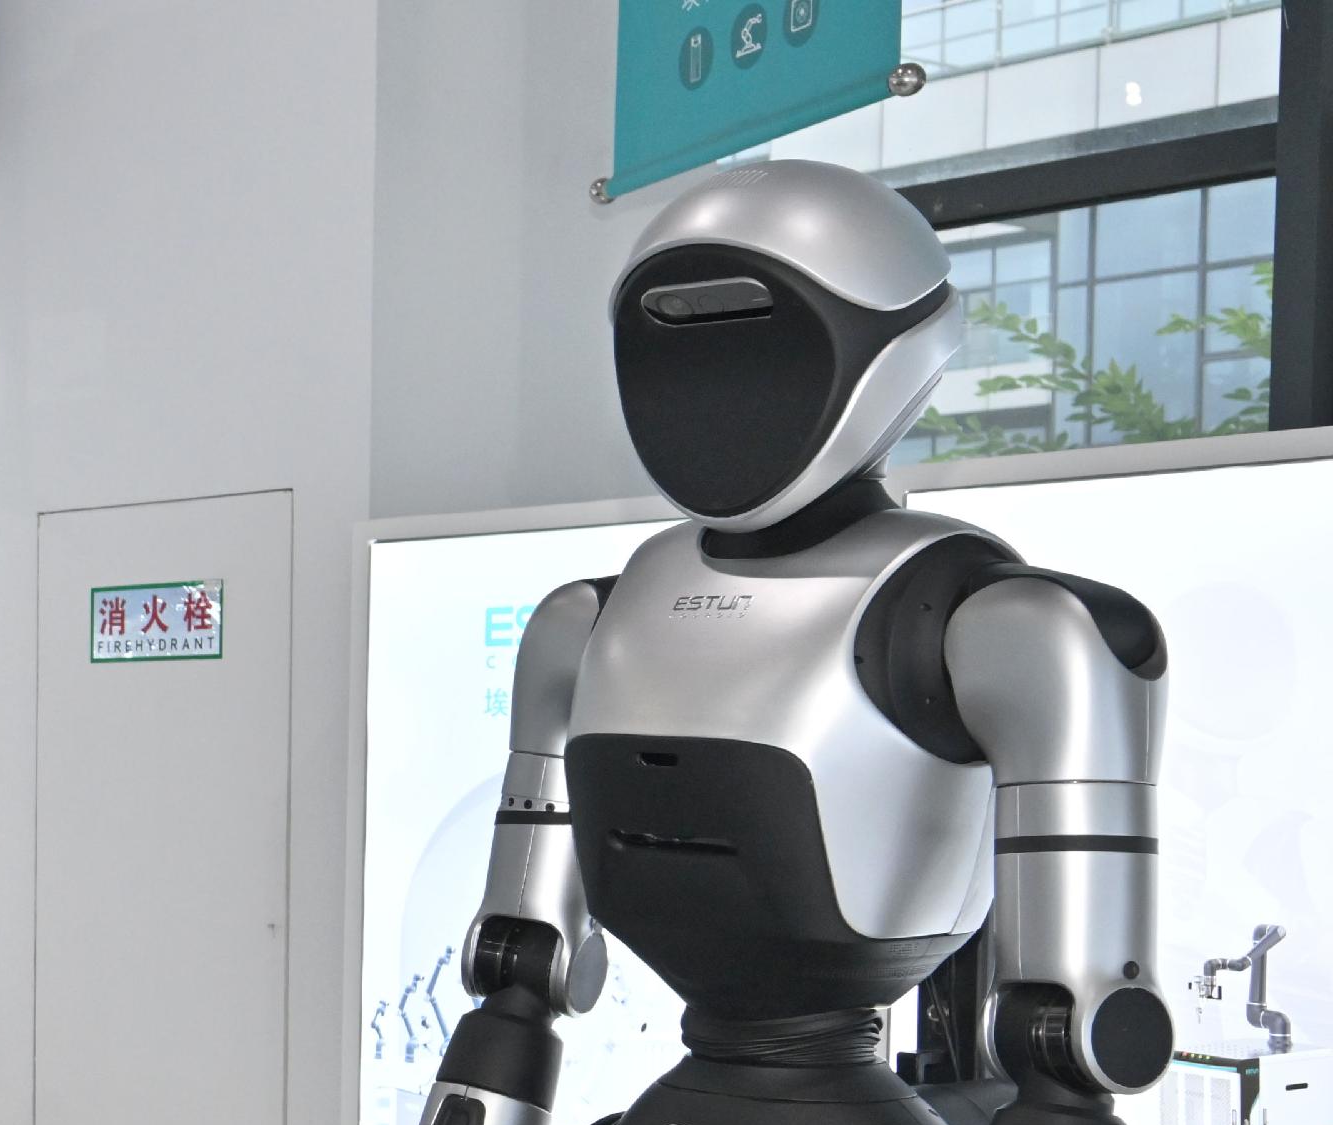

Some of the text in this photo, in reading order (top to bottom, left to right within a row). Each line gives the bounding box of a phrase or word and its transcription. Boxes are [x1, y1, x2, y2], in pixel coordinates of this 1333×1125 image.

[673, 594, 753, 611] ESTUN
[99, 590, 213, 636] 消火栓
[97, 636, 215, 654] FIREHYDRANT
